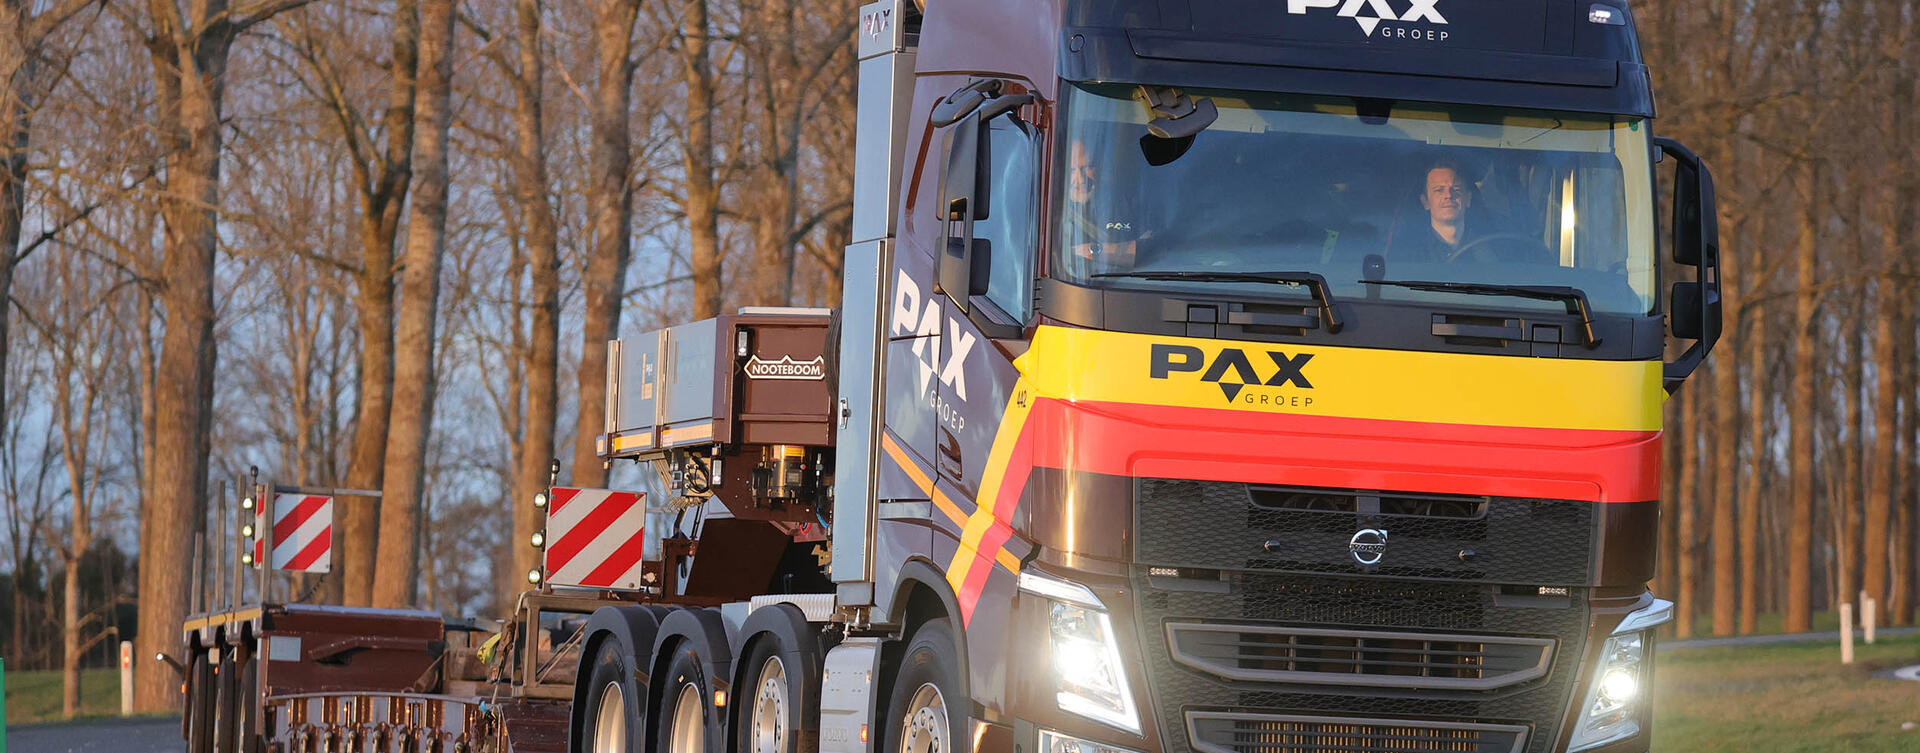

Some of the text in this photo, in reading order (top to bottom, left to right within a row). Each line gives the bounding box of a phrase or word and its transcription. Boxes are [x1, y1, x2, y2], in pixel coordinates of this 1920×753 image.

[1382, 27, 1449, 41] GROEP
[1106, 222, 1131, 231] PAX
[892, 268, 976, 402] PAX
[752, 364, 821, 375] NOOTEBOOM
[1150, 344, 1315, 403] PAX
[1245, 394, 1313, 407] GROEP
[931, 391, 965, 433] GROEP
